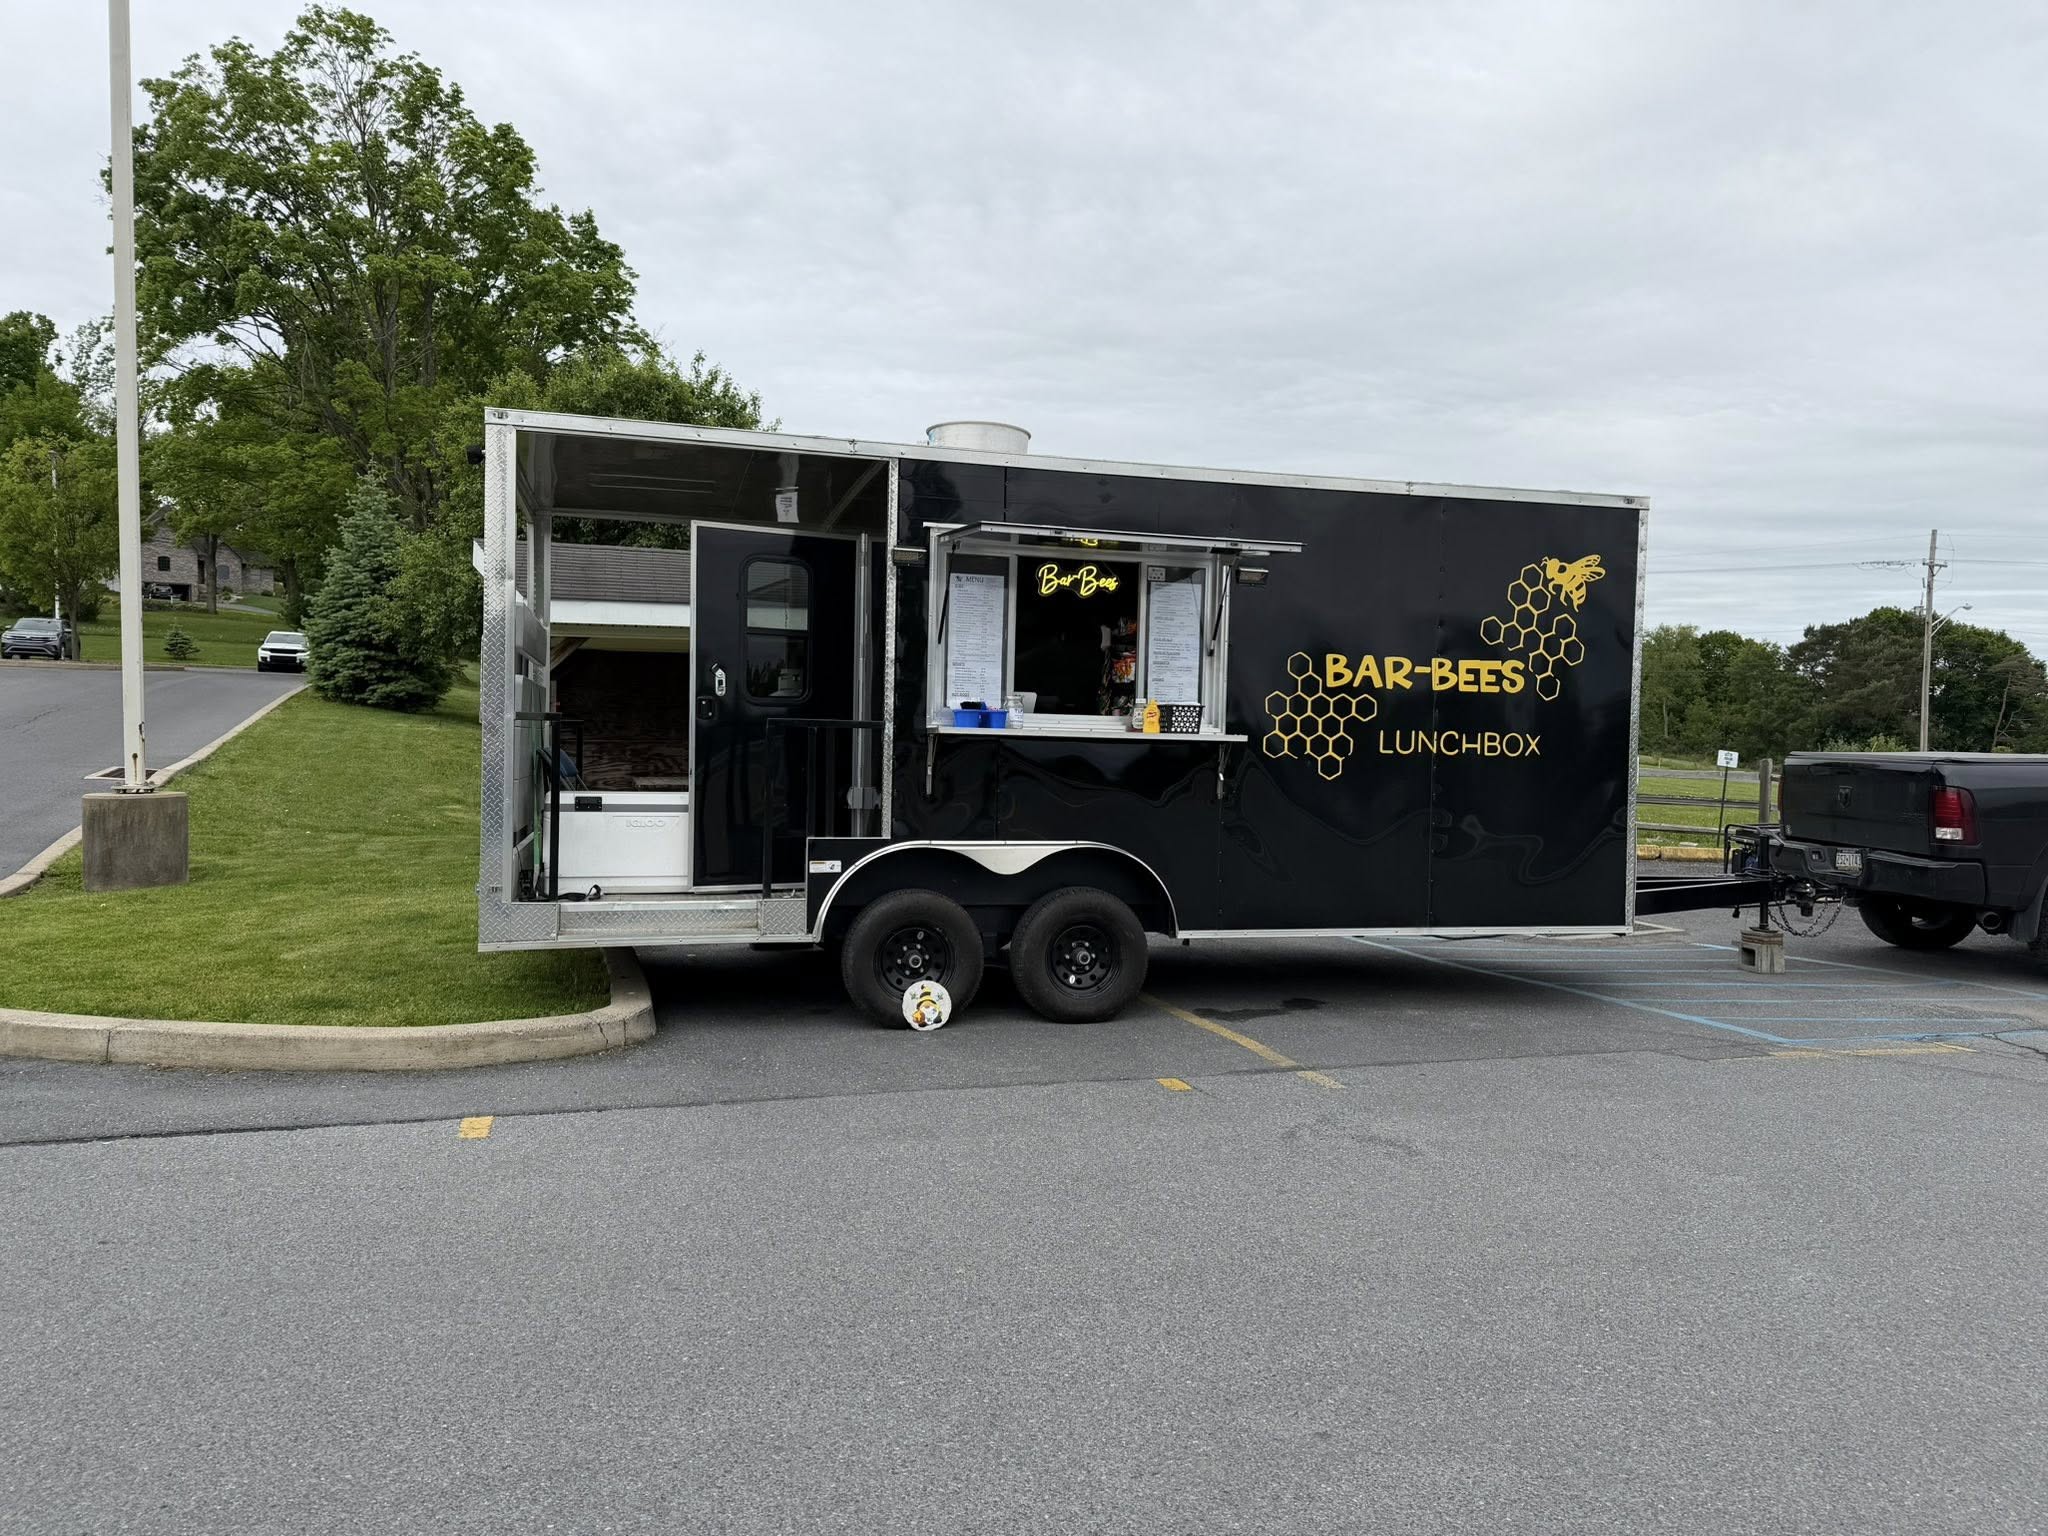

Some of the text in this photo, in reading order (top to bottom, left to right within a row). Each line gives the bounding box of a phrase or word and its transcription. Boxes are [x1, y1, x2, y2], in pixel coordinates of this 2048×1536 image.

[965, 575, 984, 583] MENU
[1325, 653, 1525, 693] BAR-BEES
[1378, 729, 1541, 757] LUNCHBOX
[625, 818, 666, 828] IGLOO
